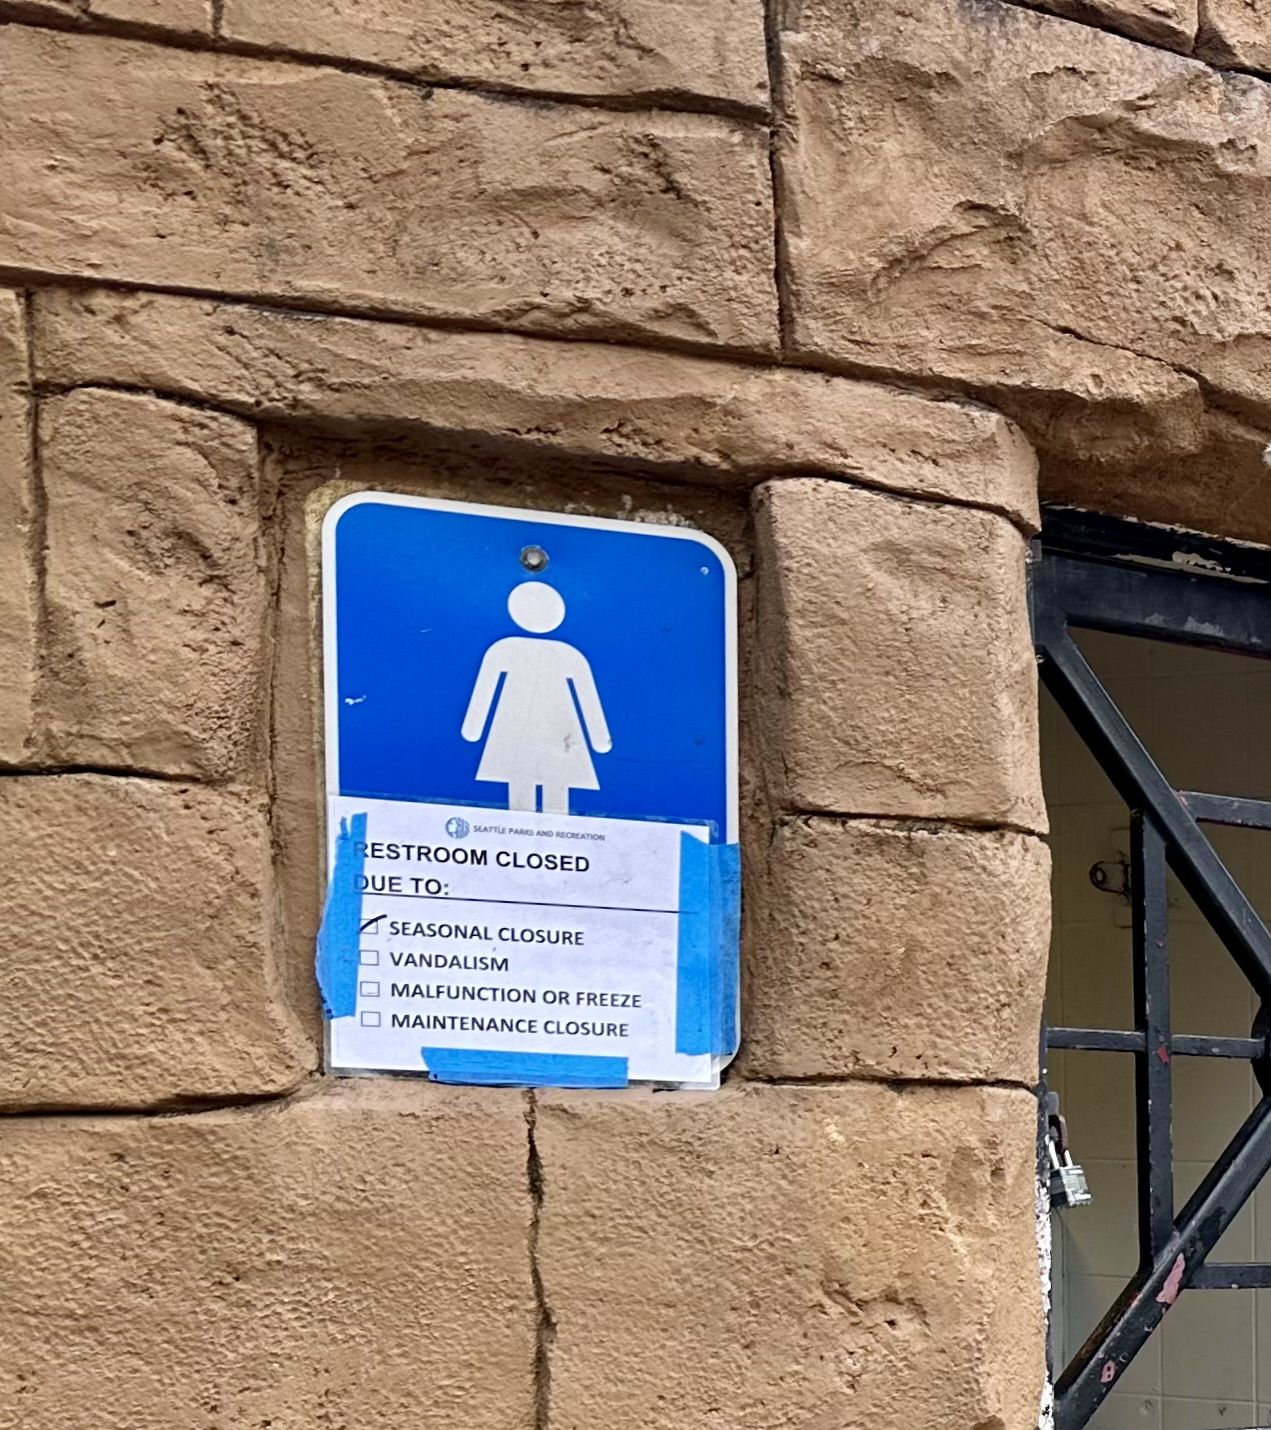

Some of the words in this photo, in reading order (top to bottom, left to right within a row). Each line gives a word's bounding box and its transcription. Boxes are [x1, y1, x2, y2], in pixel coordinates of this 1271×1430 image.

[473, 824, 506, 835] SEATTLE
[509, 827, 534, 837] PARKS
[536, 829, 553, 838] AND
[555, 830, 605, 841] RECREATION
[353, 841, 487, 867] RESTROOM
[495, 850, 590, 872] CLOSED
[354, 874, 402, 893] DUE
[410, 877, 449, 896] TO:
[389, 920, 493, 941] SEASONAL
[498, 926, 585, 946] CLOSURE
[389, 951, 509, 972] VANDALISM
[390, 982, 536, 1004] MALFUNCTION
[542, 989, 570, 1007] OR
[575, 991, 642, 1008] FREEZE
[391, 1013, 538, 1034] MAINTENANCE
[543, 1019, 629, 1038] CLOSURE
